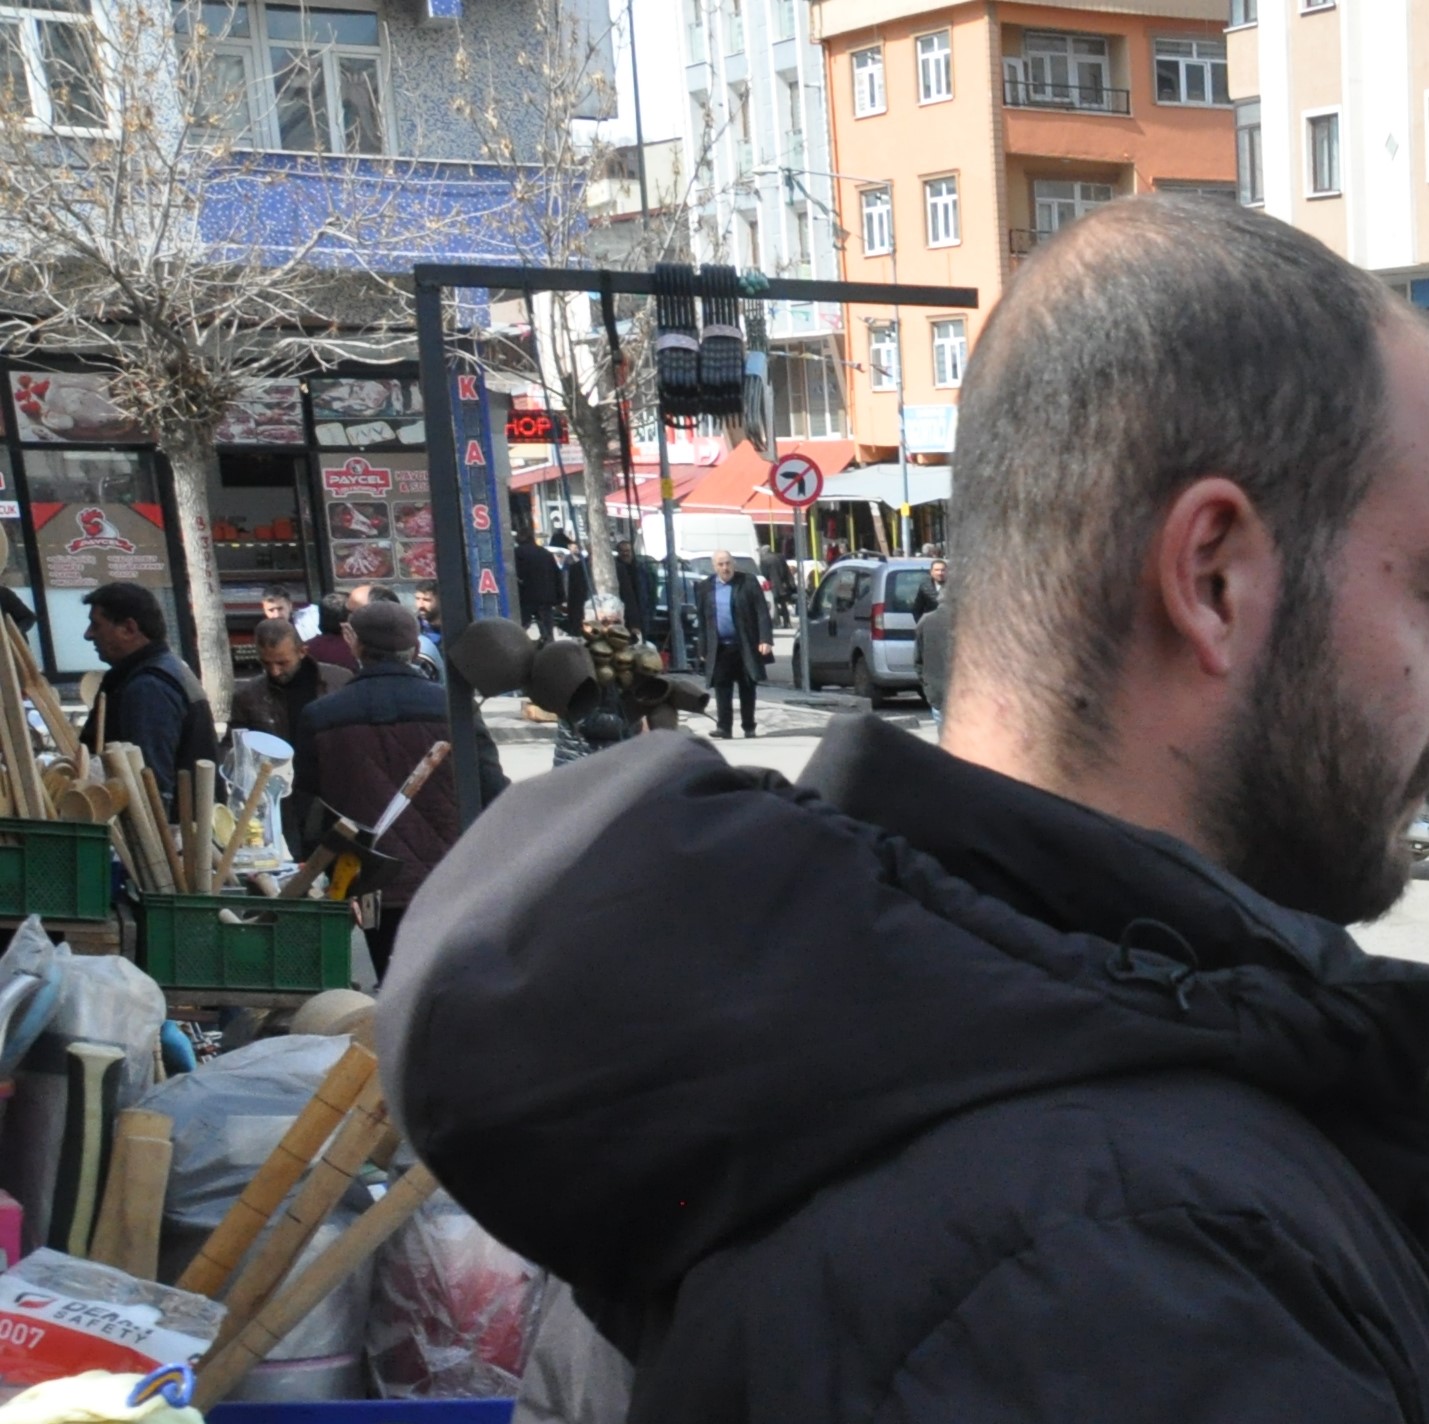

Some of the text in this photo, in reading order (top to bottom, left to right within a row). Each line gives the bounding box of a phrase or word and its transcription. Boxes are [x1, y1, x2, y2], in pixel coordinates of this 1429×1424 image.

[329, 475, 385, 485] PAYCEL
[458, 373, 499, 594] KASA
[53, 1311, 149, 1344] SAFETY
